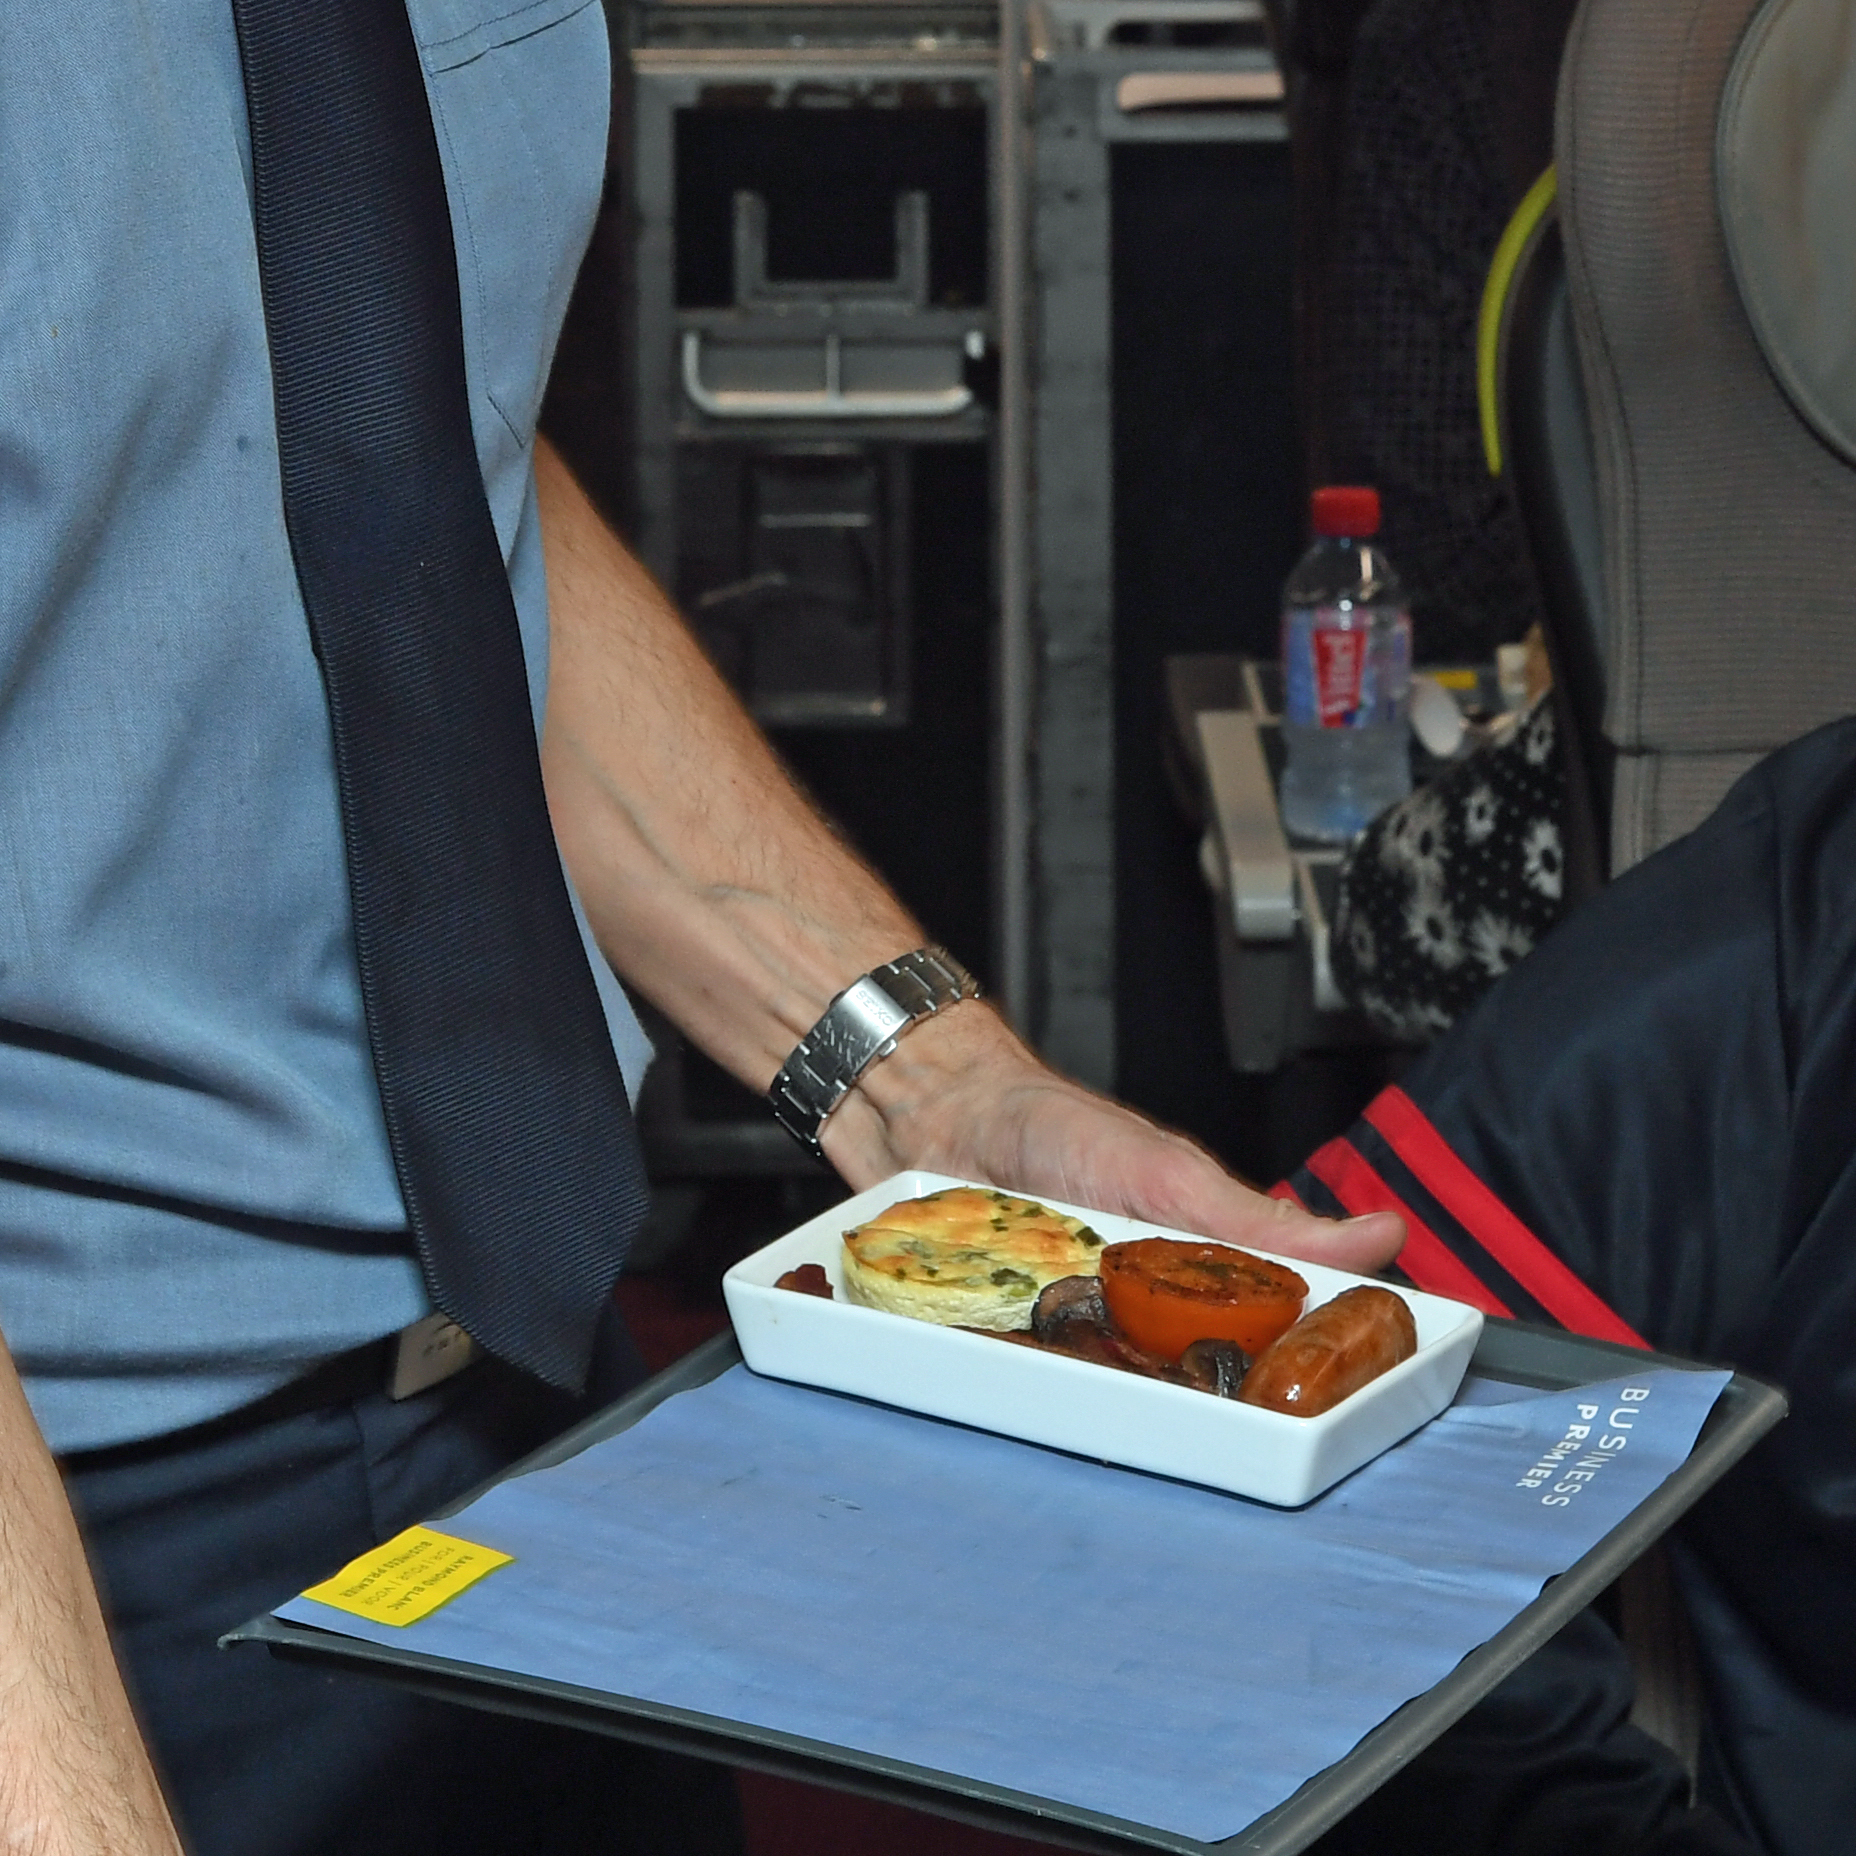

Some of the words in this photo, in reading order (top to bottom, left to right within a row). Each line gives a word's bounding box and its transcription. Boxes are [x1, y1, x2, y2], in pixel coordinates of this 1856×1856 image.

[1515, 1403, 1599, 1489] PREMIER
[1541, 1387, 1650, 1507] BUSINESS
[381, 1540, 433, 1569] BUSINESS
[419, 1554, 474, 1587] RAYMOND
[337, 1566, 388, 1598] PREMIER
[385, 1585, 426, 1611] BLANC
